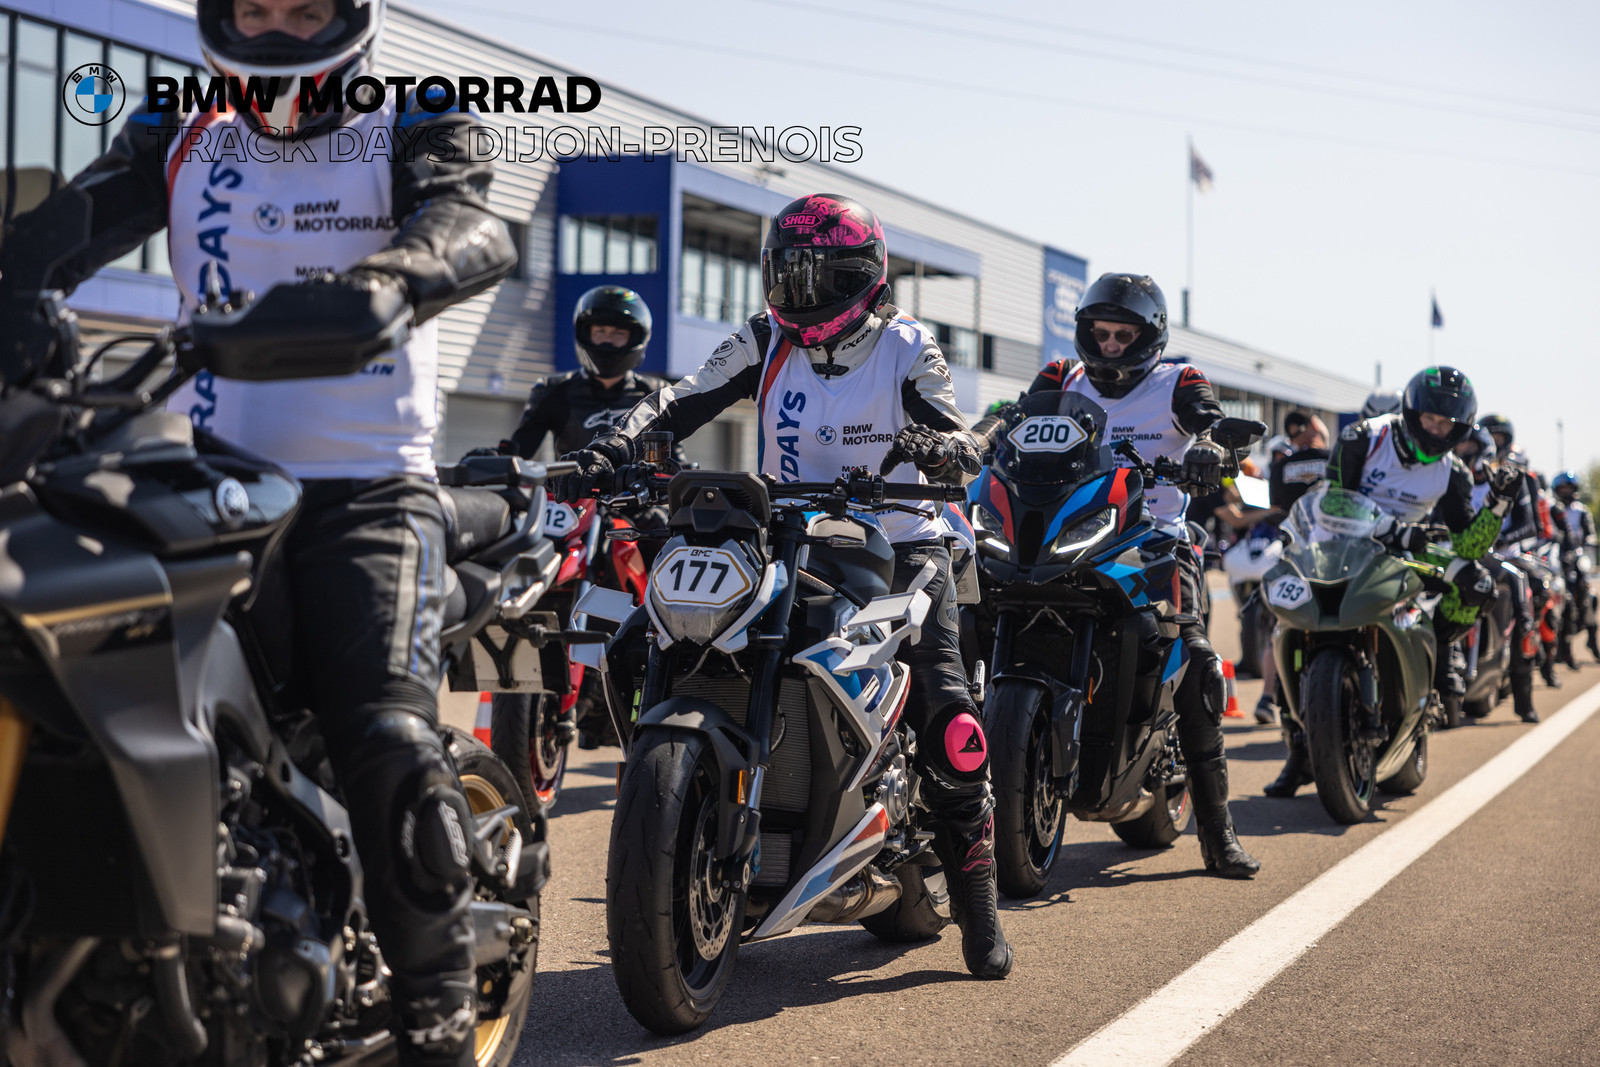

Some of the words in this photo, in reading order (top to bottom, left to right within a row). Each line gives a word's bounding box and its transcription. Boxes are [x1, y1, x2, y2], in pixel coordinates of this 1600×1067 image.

[294, 200, 341, 216] BMW
[294, 215, 398, 233] MOTORRAD
[783, 215, 817, 226] SHOEI
[841, 326, 873, 351] IXON
[842, 423, 873, 435] BMW
[1023, 424, 1070, 444] 200
[1110, 432, 1163, 442] MOTORRAD
[1111, 426, 1135, 434] BMW
[842, 433, 894, 446] MOTORR
[1358, 468, 1387, 497] AYS
[669, 559, 730, 595] 177
[1276, 580, 1305, 602] 193
